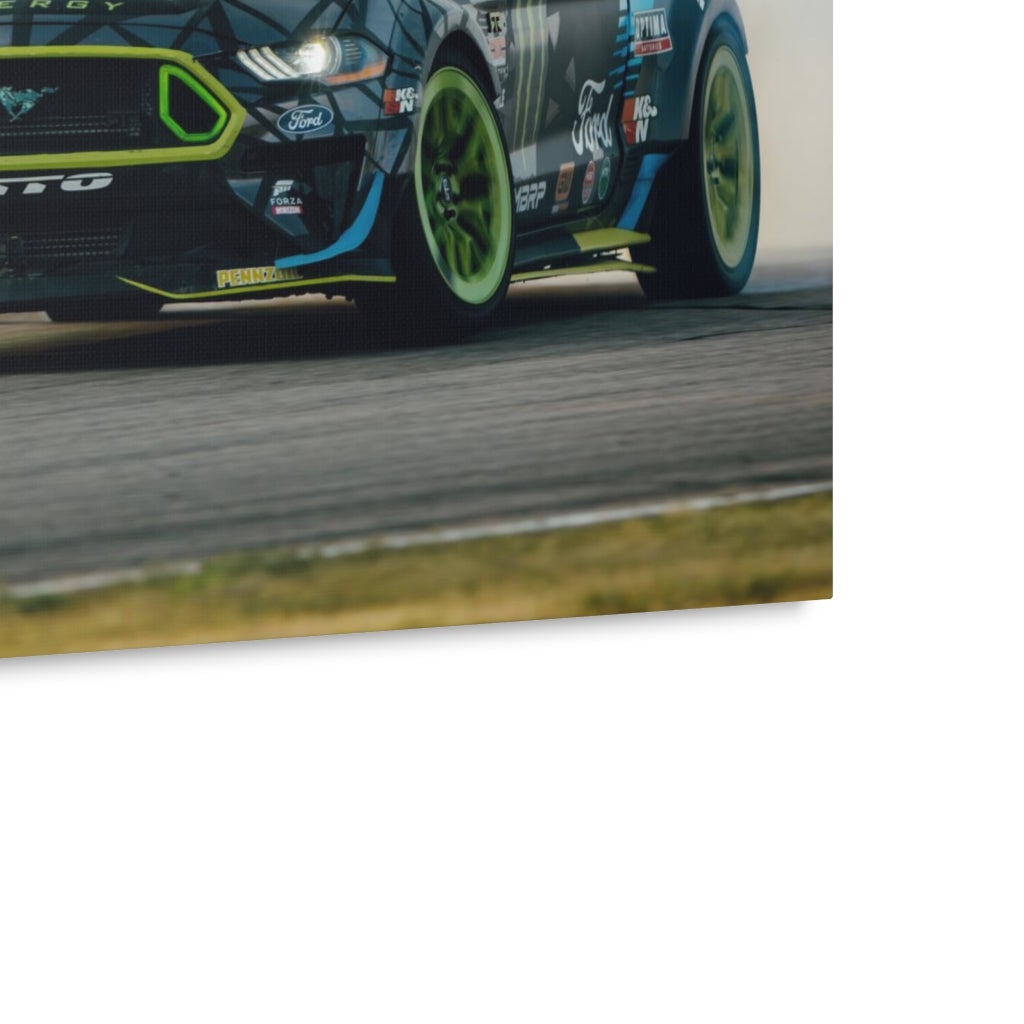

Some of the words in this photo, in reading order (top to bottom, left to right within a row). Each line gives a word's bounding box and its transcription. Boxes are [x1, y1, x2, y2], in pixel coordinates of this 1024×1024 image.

[635, 13, 668, 41] OPTIMA
[288, 108, 324, 131] Ford
[572, 79, 614, 156] Ford
[269, 197, 304, 206] FORZA
